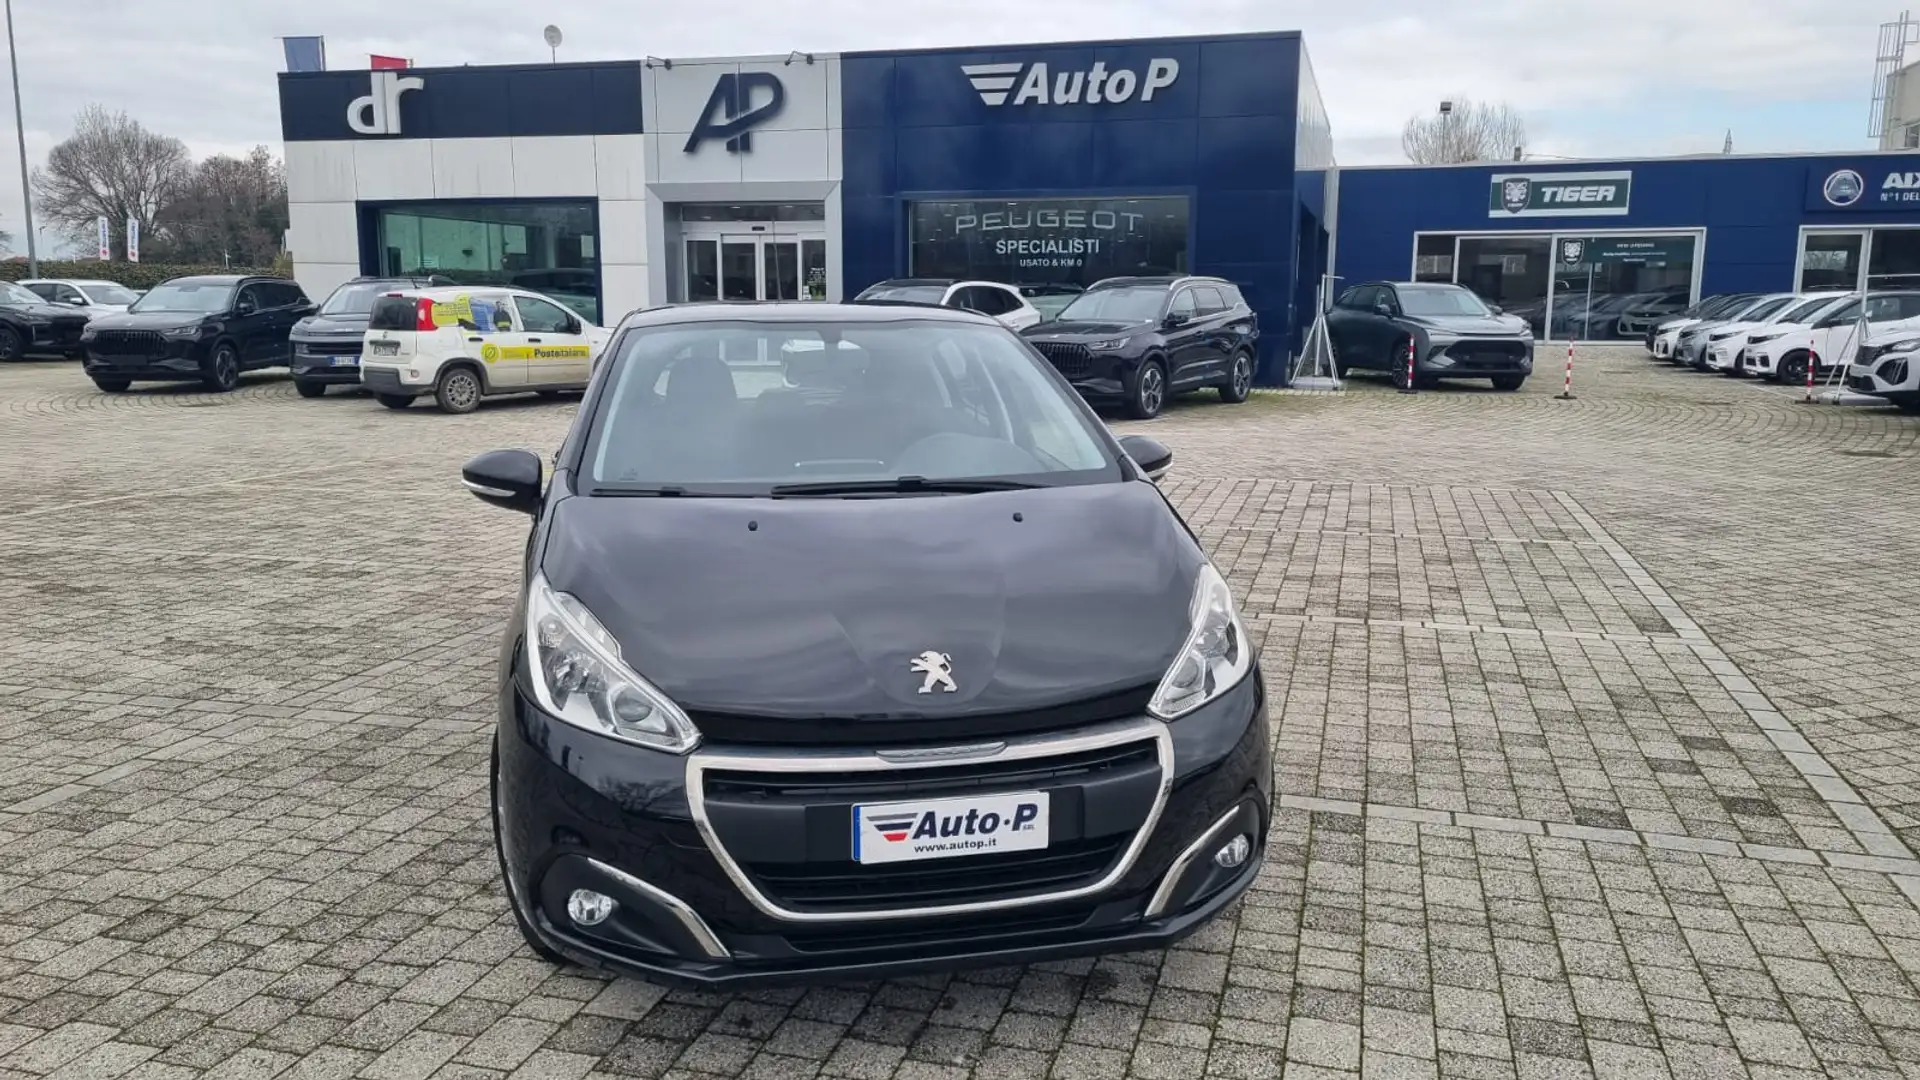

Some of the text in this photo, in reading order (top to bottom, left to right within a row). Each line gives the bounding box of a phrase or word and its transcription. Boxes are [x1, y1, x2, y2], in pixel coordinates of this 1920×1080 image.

[1013, 58, 1179, 105] Auto P
[346, 72, 424, 134] dr
[683, 72, 784, 152] AP
[1541, 185, 1616, 203] TIGER
[956, 210, 1143, 234] PEUGEOT
[995, 239, 1099, 254] SPECIALISTI
[1019, 259, 1049, 267] USATO
[1051, 259, 1058, 267] &
[1060, 259, 1074, 267] KM
[914, 838, 997, 853] www.autop.it
